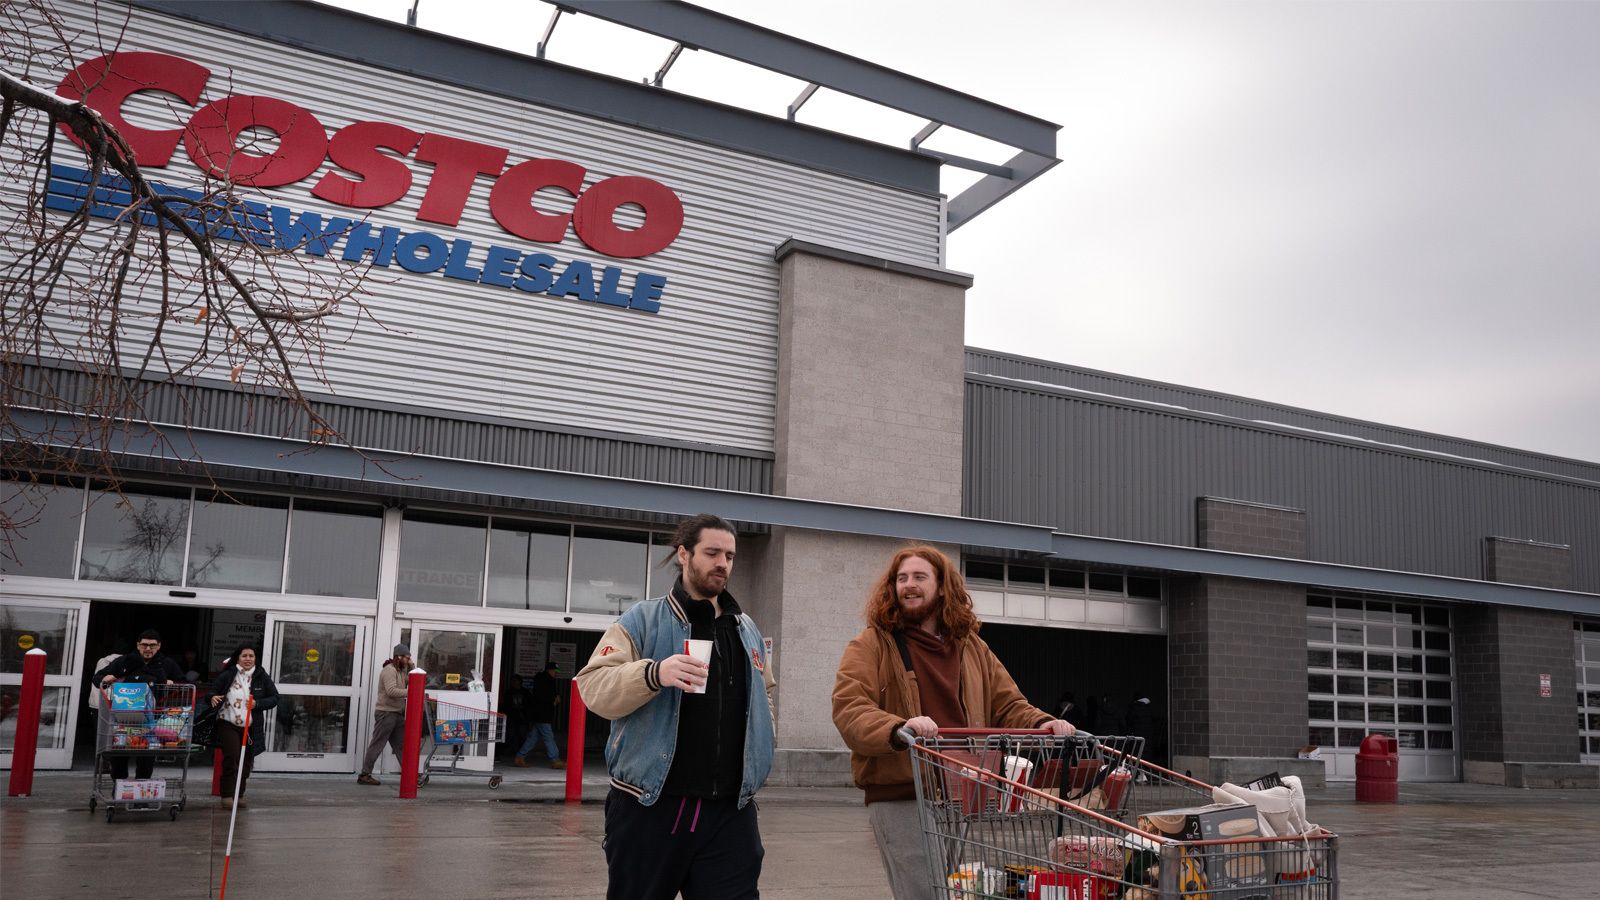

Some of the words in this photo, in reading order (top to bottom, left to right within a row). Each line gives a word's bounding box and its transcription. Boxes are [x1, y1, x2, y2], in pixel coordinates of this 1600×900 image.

[56, 51, 684, 258] COSTCO
[271, 206, 667, 313] WHOLESALE
[399, 569, 477, 586] TRANCE
[1192, 821, 1199, 835] 2
